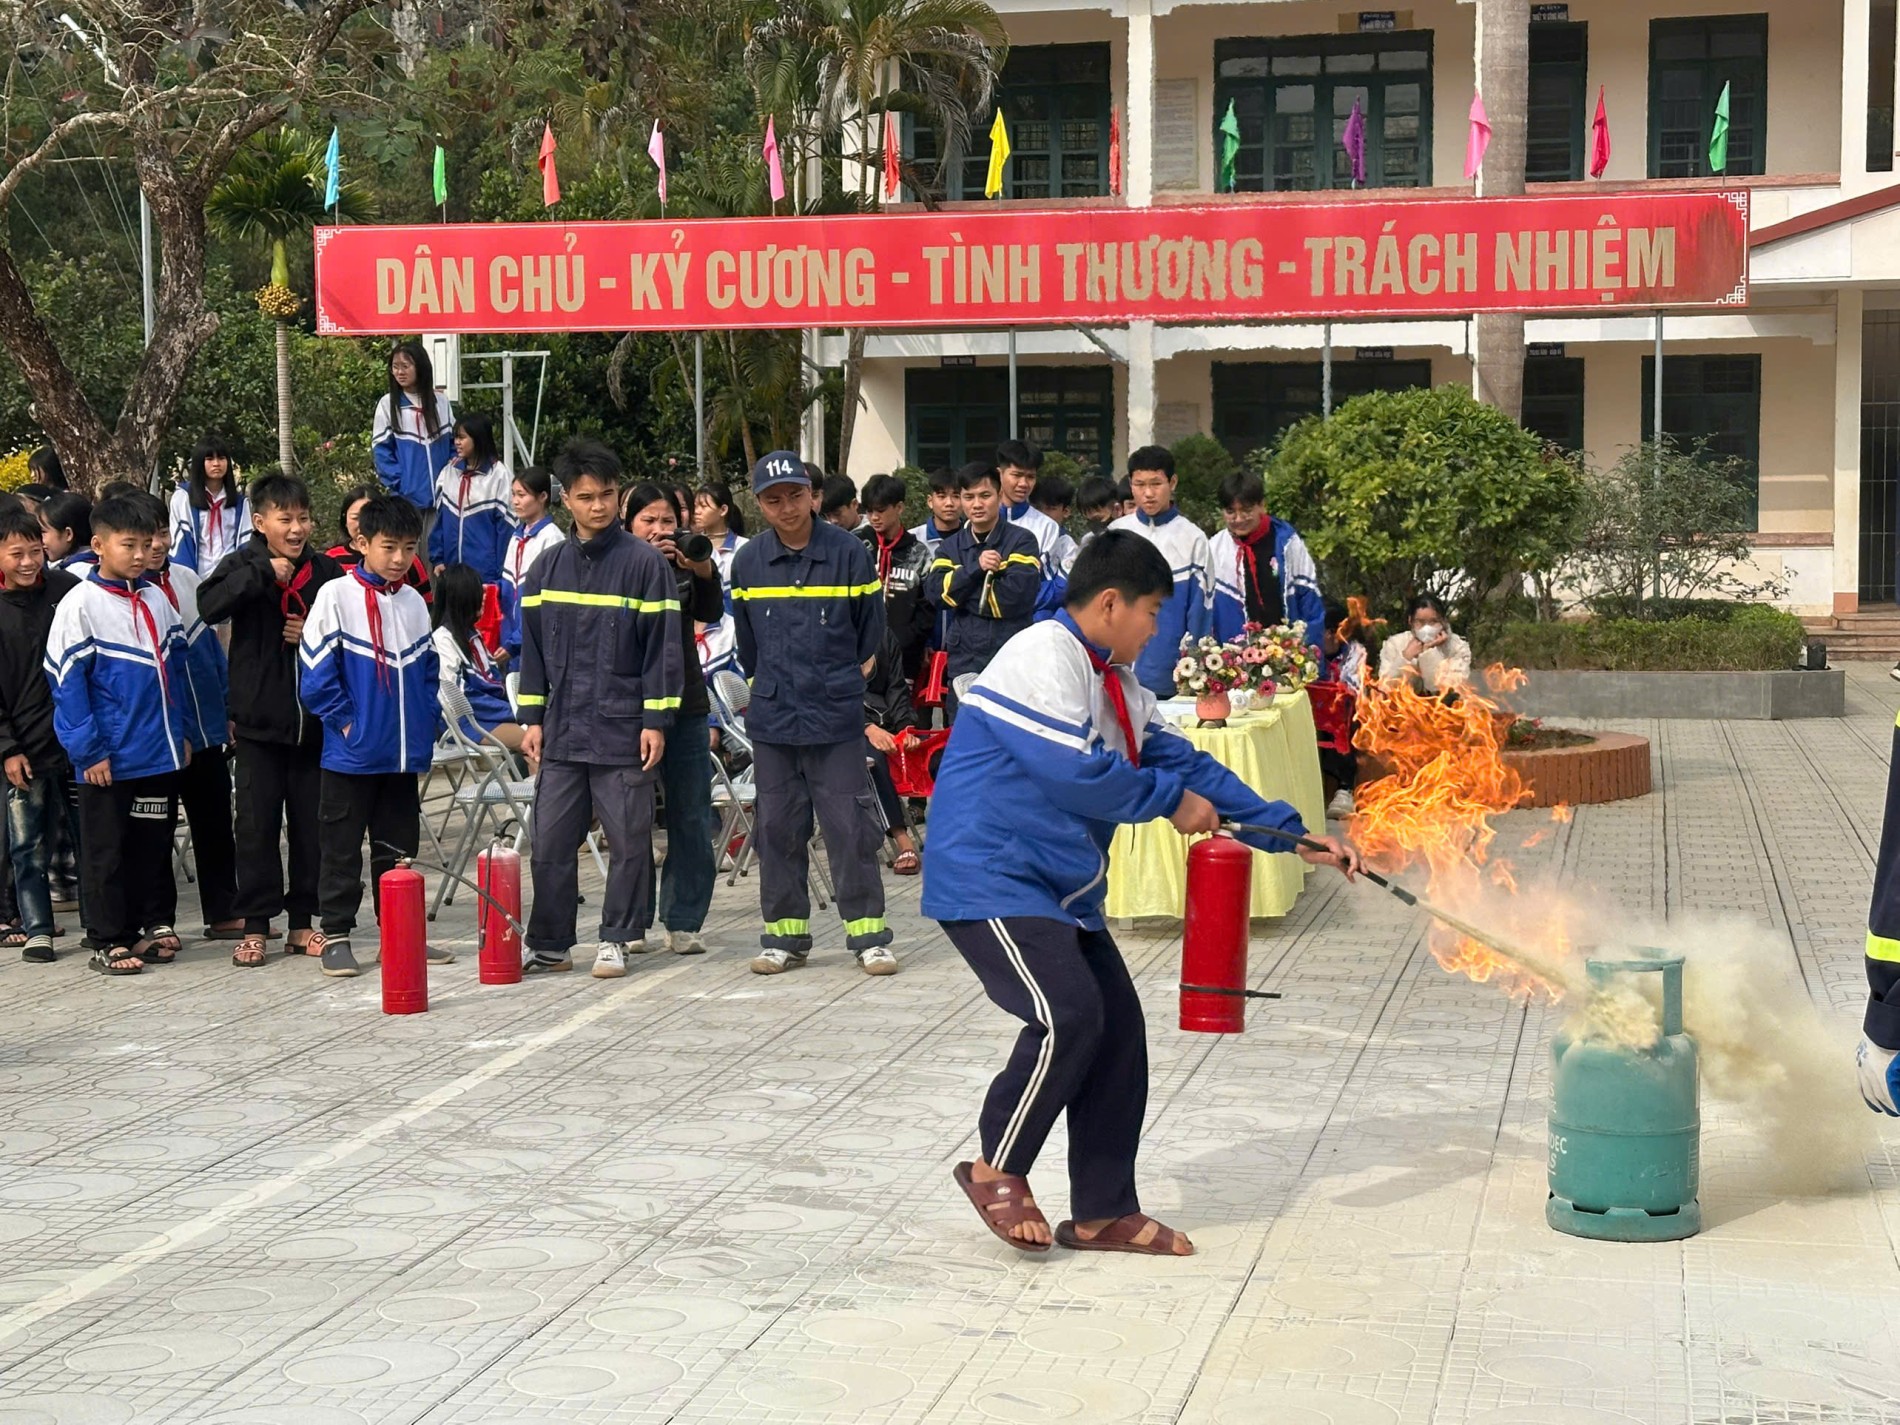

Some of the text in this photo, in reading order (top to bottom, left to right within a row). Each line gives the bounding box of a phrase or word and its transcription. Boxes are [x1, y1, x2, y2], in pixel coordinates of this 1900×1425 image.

[377, 244, 475, 313] DÂN
[490, 233, 585, 312] CHỦ
[631, 228, 692, 310] KỶ
[707, 240, 875, 308] CƯƠNG
[923, 231, 1040, 303] TÌNH
[1057, 234, 1263, 301] THƯƠNG
[1305, 218, 1477, 295] TRÁCH
[1495, 213, 1676, 302] NHIỆM
[766, 459, 794, 477] 114
